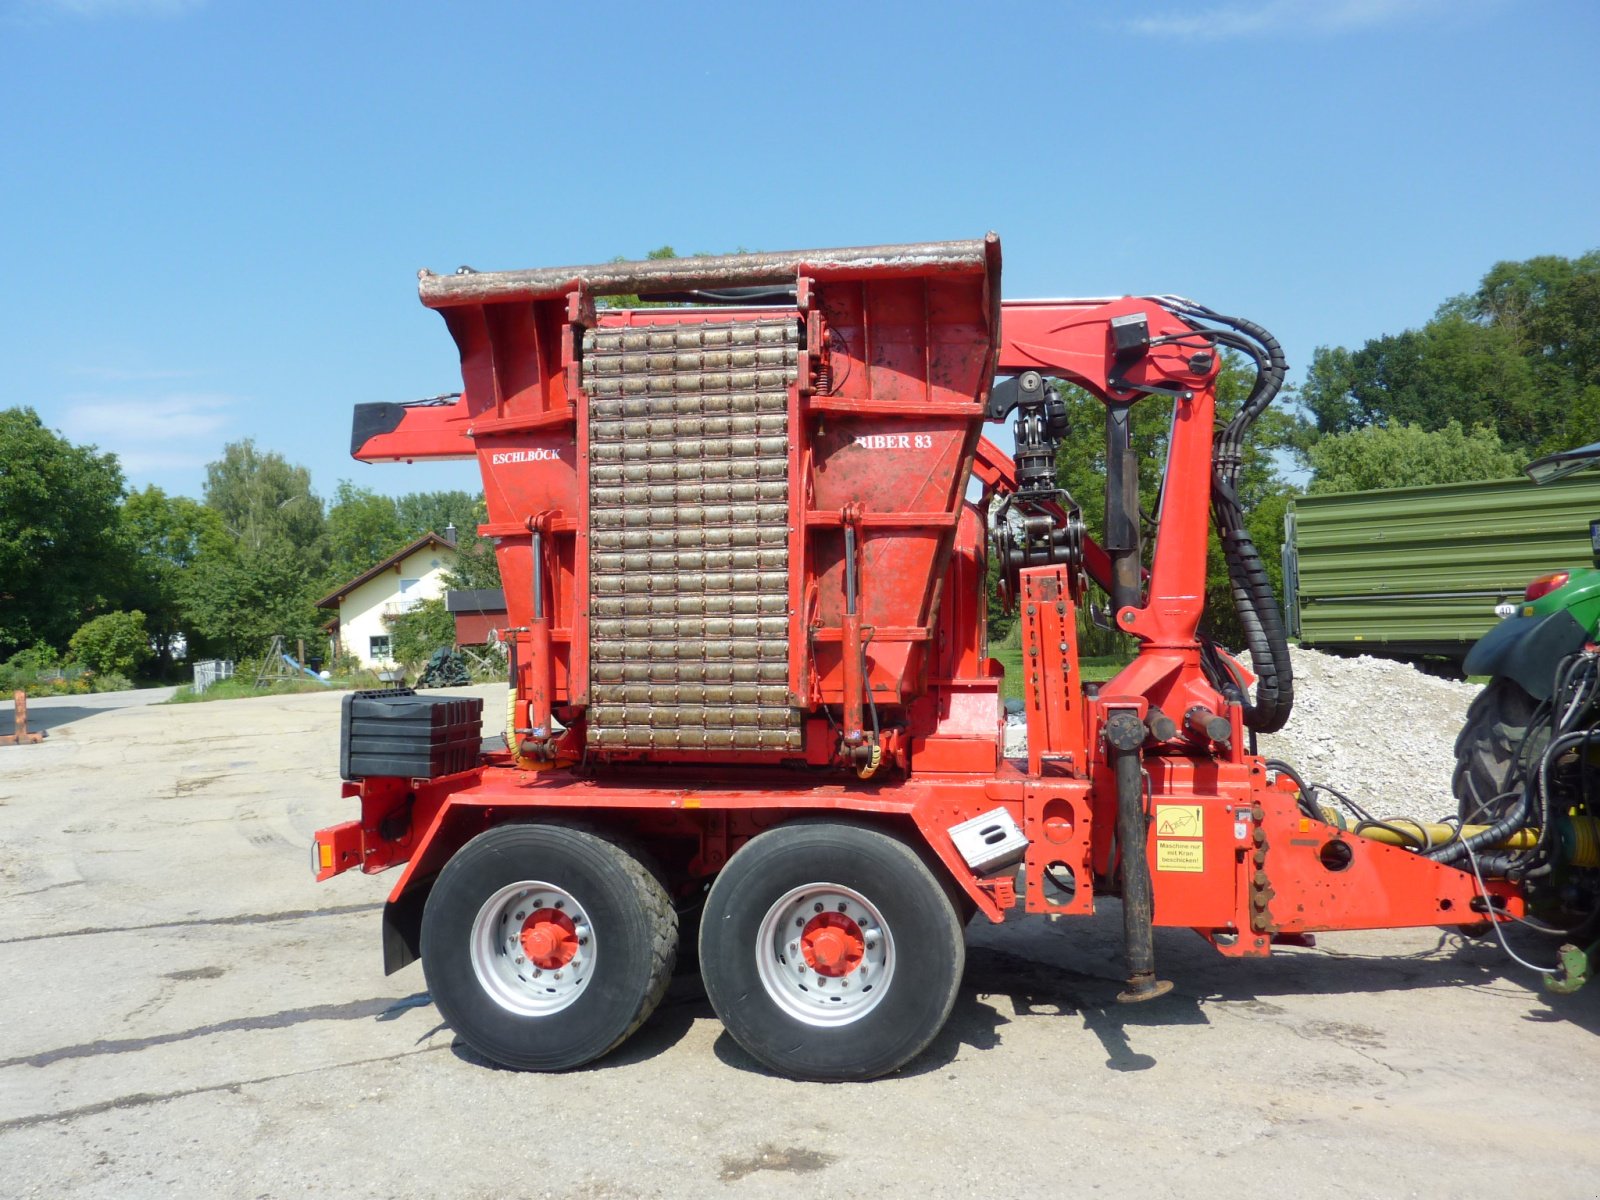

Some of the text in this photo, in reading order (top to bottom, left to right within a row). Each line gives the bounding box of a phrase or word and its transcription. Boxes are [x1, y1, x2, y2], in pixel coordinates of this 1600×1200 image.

[914, 434, 932, 449] 83
[492, 447, 561, 465] ESCHLBÖCK
[1500, 606, 1511, 615] 40
